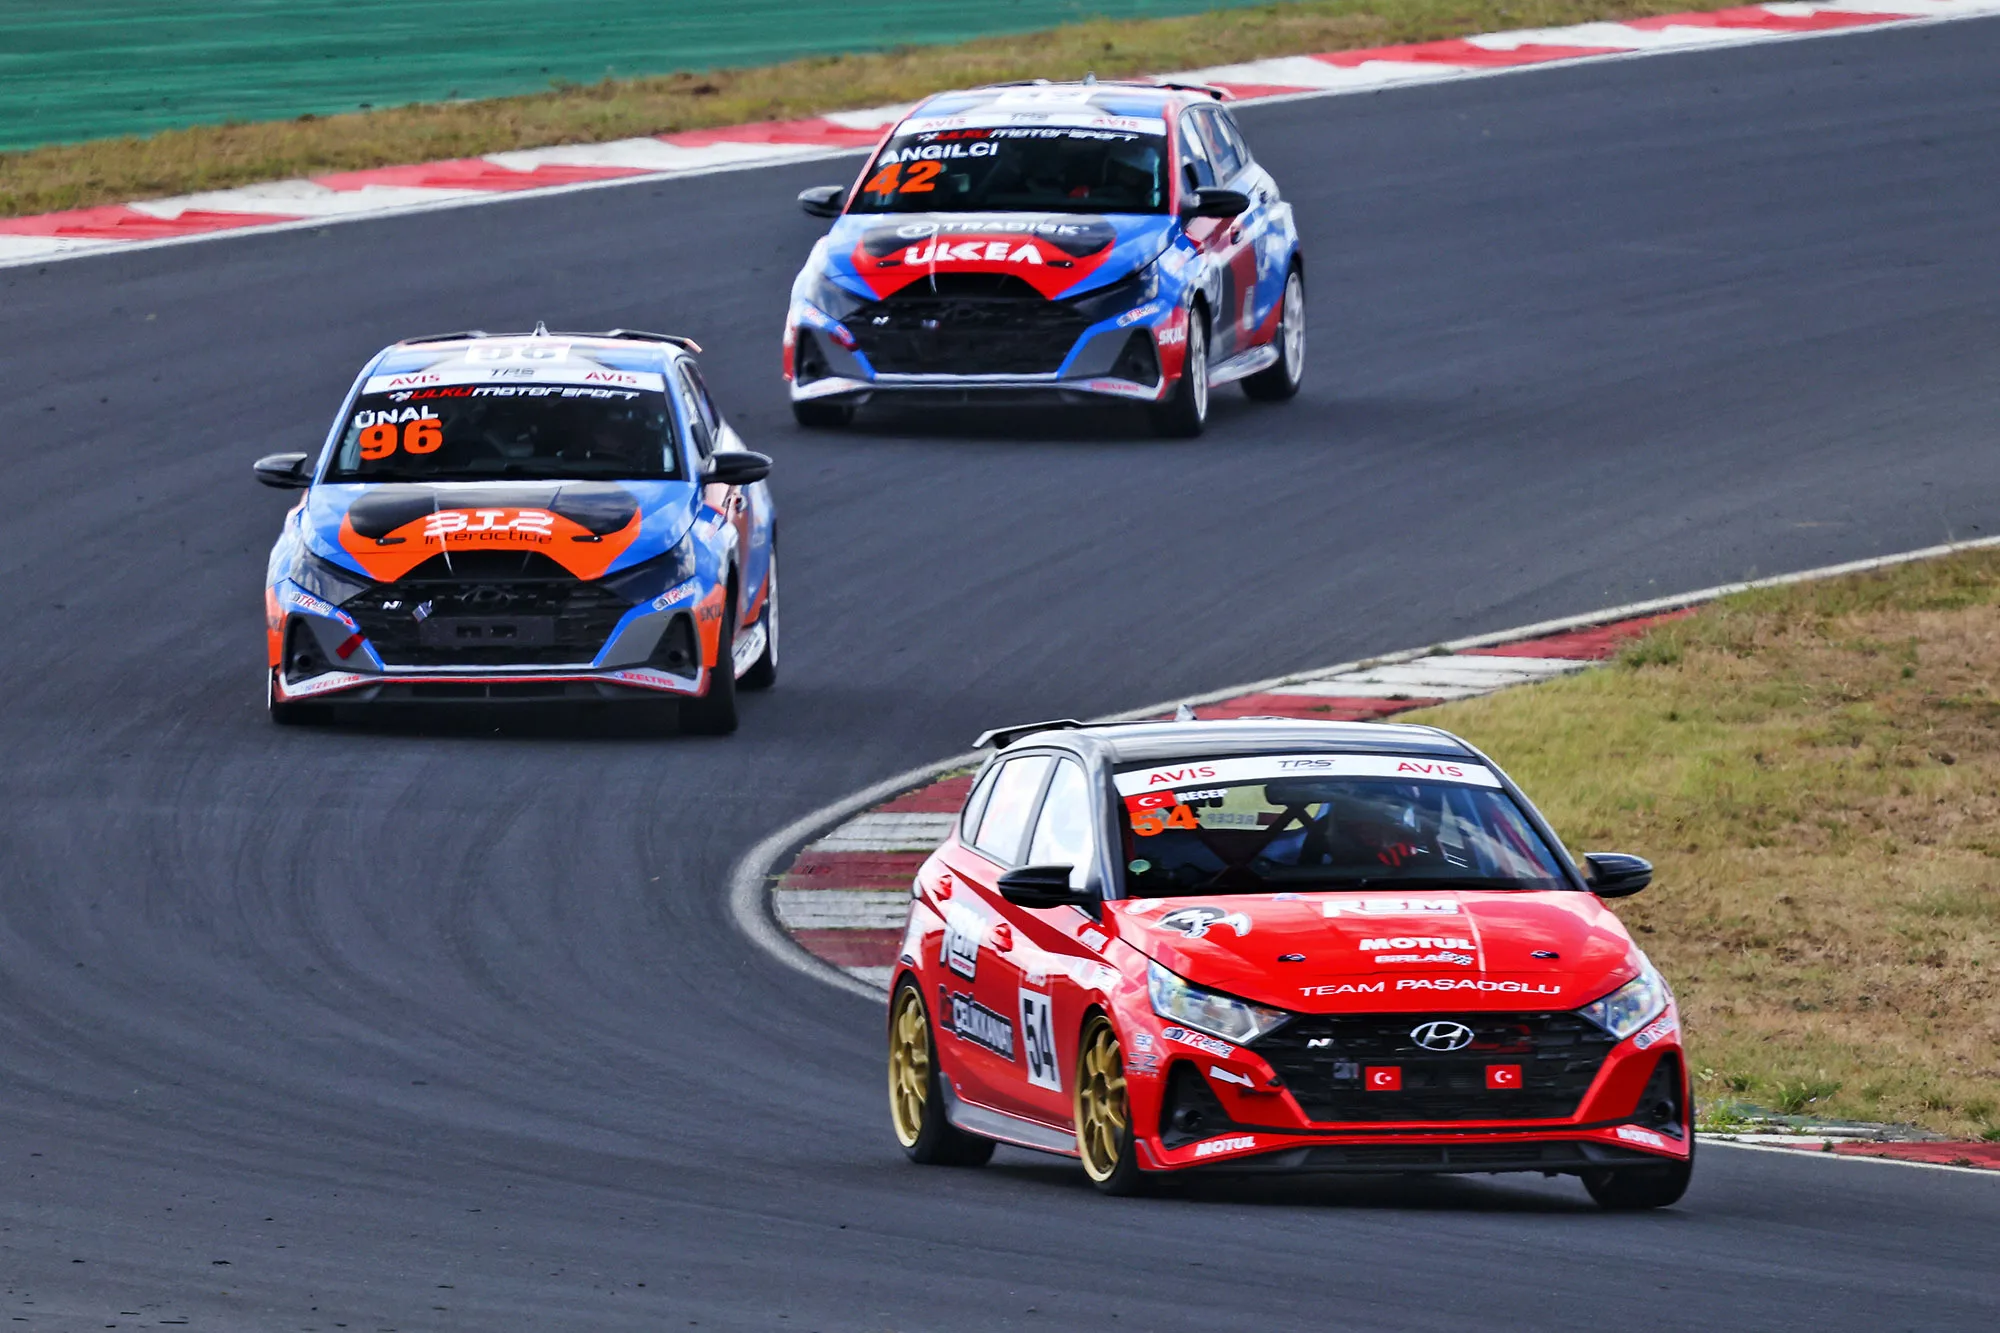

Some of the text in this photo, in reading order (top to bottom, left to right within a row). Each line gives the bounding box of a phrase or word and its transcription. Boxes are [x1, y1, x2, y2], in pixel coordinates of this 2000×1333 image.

[922, 117, 967, 128] AVIS
[1092, 117, 1139, 129] AVIS
[864, 160, 943, 197] 42
[388, 373, 441, 387] AVIS
[585, 371, 638, 385] AVIS
[354, 405, 439, 428] ÜNAL
[359, 418, 443, 461] 96
[1148, 759, 1464, 786] AVIS TPS AVIS
[1176, 788, 1229, 803] RECEP
[1130, 803, 1200, 837] 54
[1358, 937, 1477, 951] MOTUL
[1299, 981, 1386, 998] TEAM
[1023, 997, 1056, 1083] 54
[1194, 1135, 1257, 1157] MOTUL
